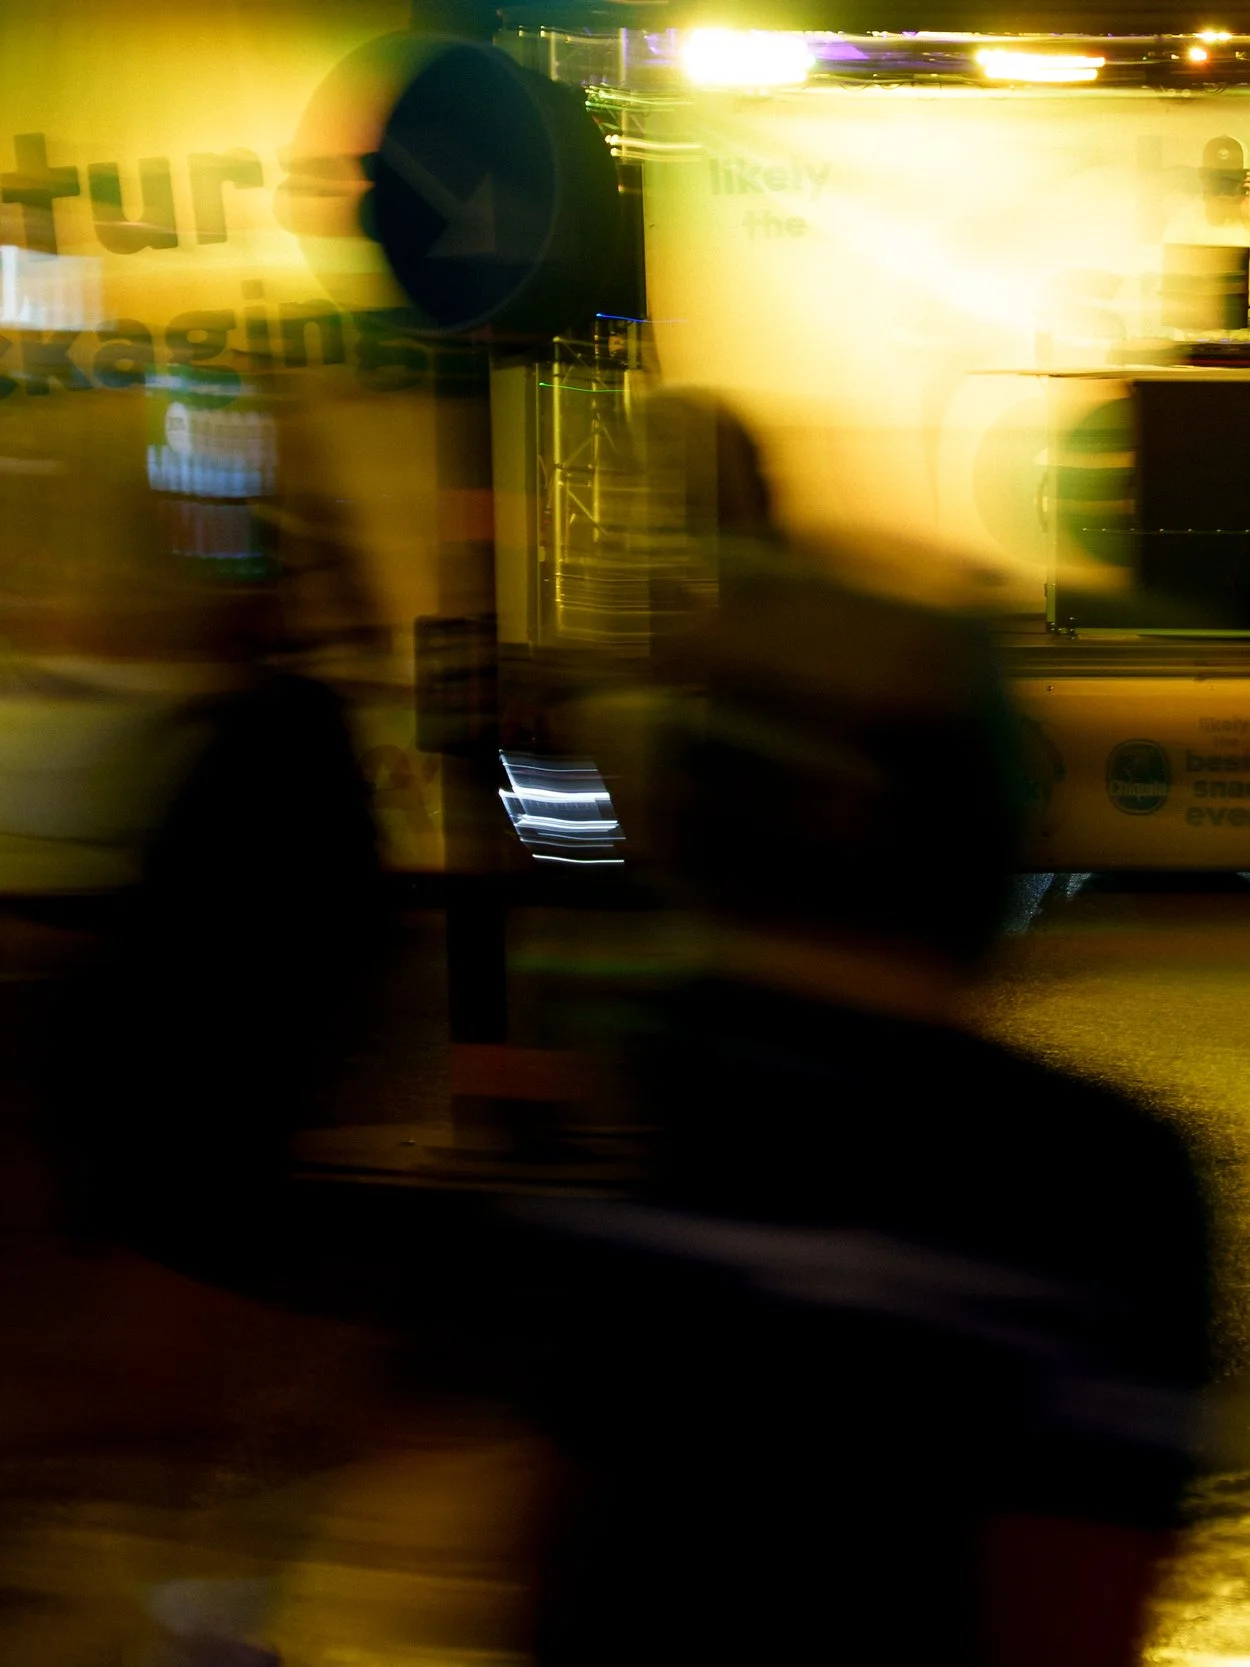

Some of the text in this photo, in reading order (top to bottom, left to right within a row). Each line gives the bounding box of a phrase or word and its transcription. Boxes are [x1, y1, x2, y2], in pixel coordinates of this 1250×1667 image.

[708, 154, 832, 203] likely
[742, 210, 808, 241] the
[0, 278, 432, 411] kaging
